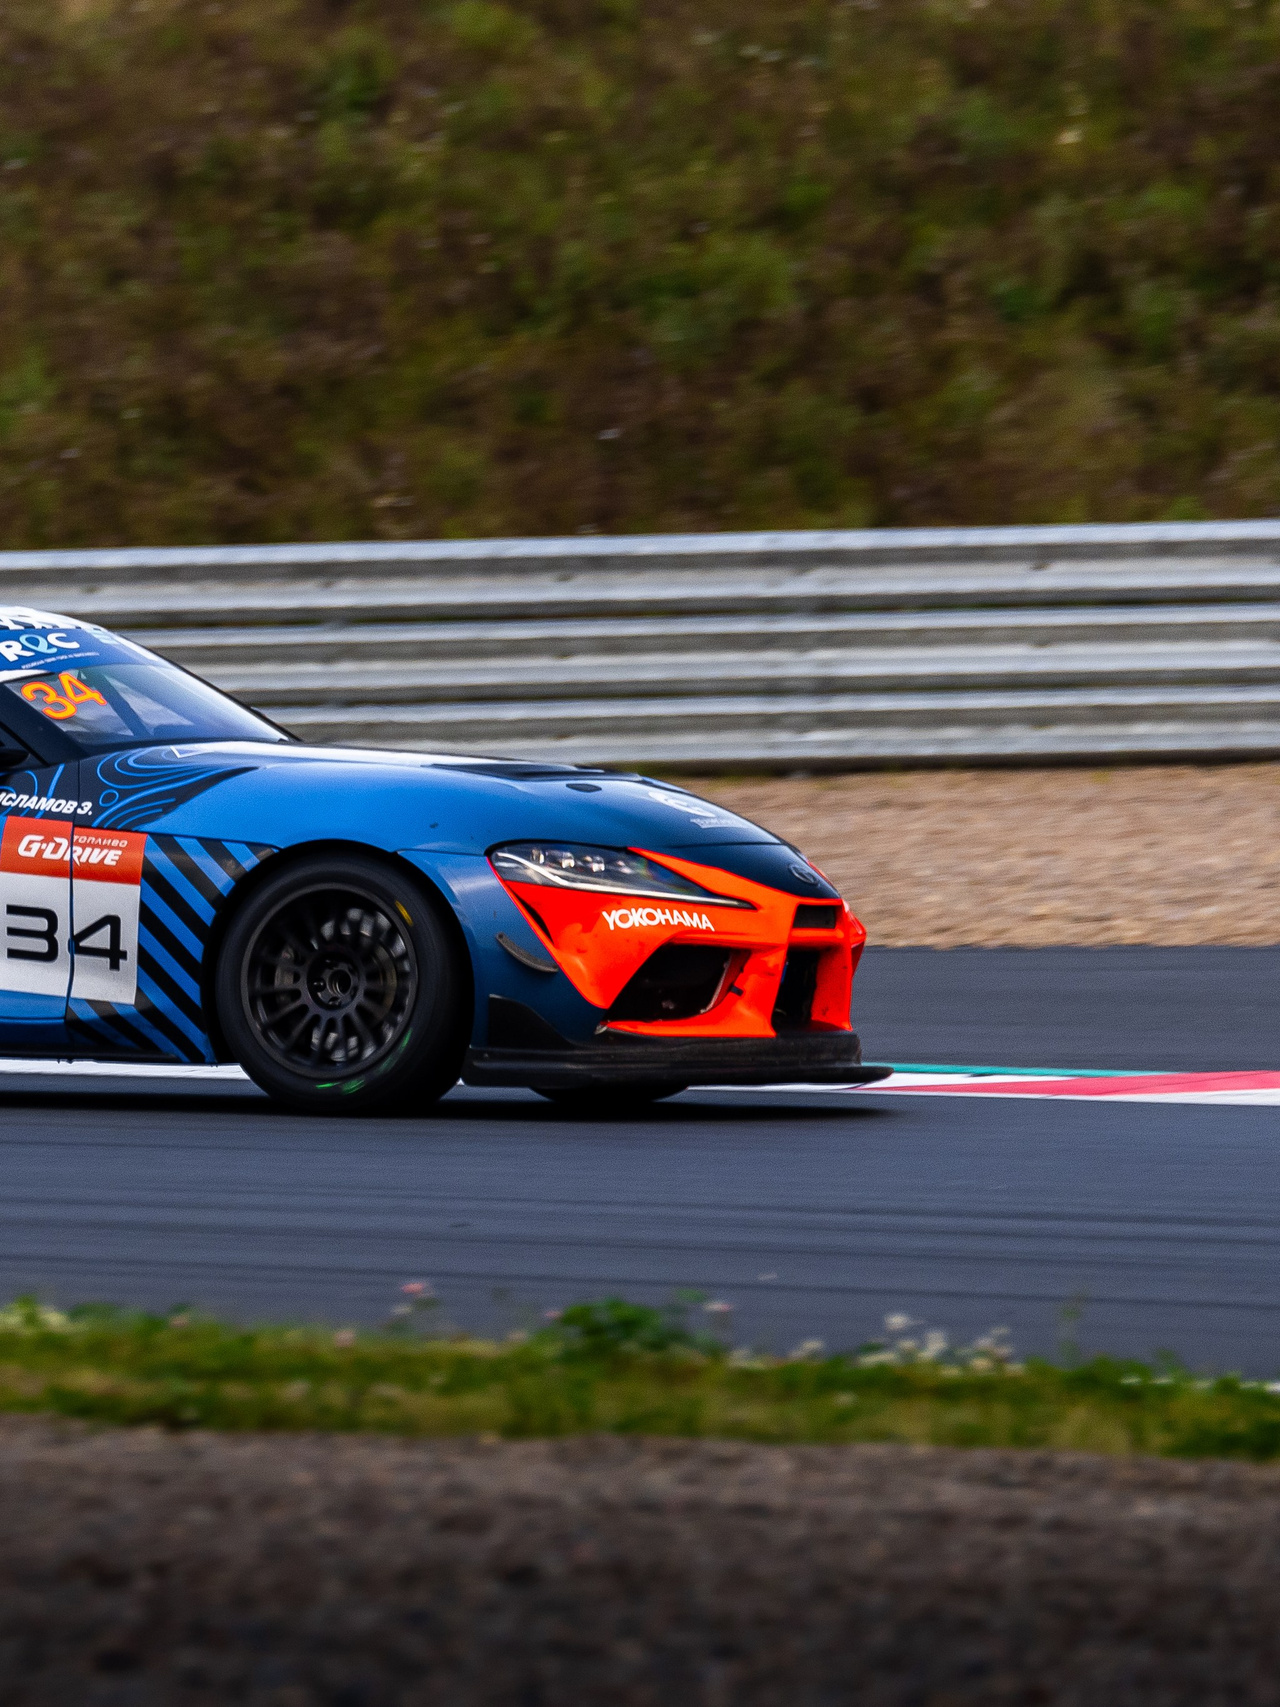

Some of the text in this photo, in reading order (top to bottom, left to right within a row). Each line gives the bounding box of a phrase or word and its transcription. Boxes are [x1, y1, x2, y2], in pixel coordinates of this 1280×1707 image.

[21, 671, 108, 719] 34
[6, 903, 128, 972] 34
[601, 907, 716, 932] YOKOHAMA
